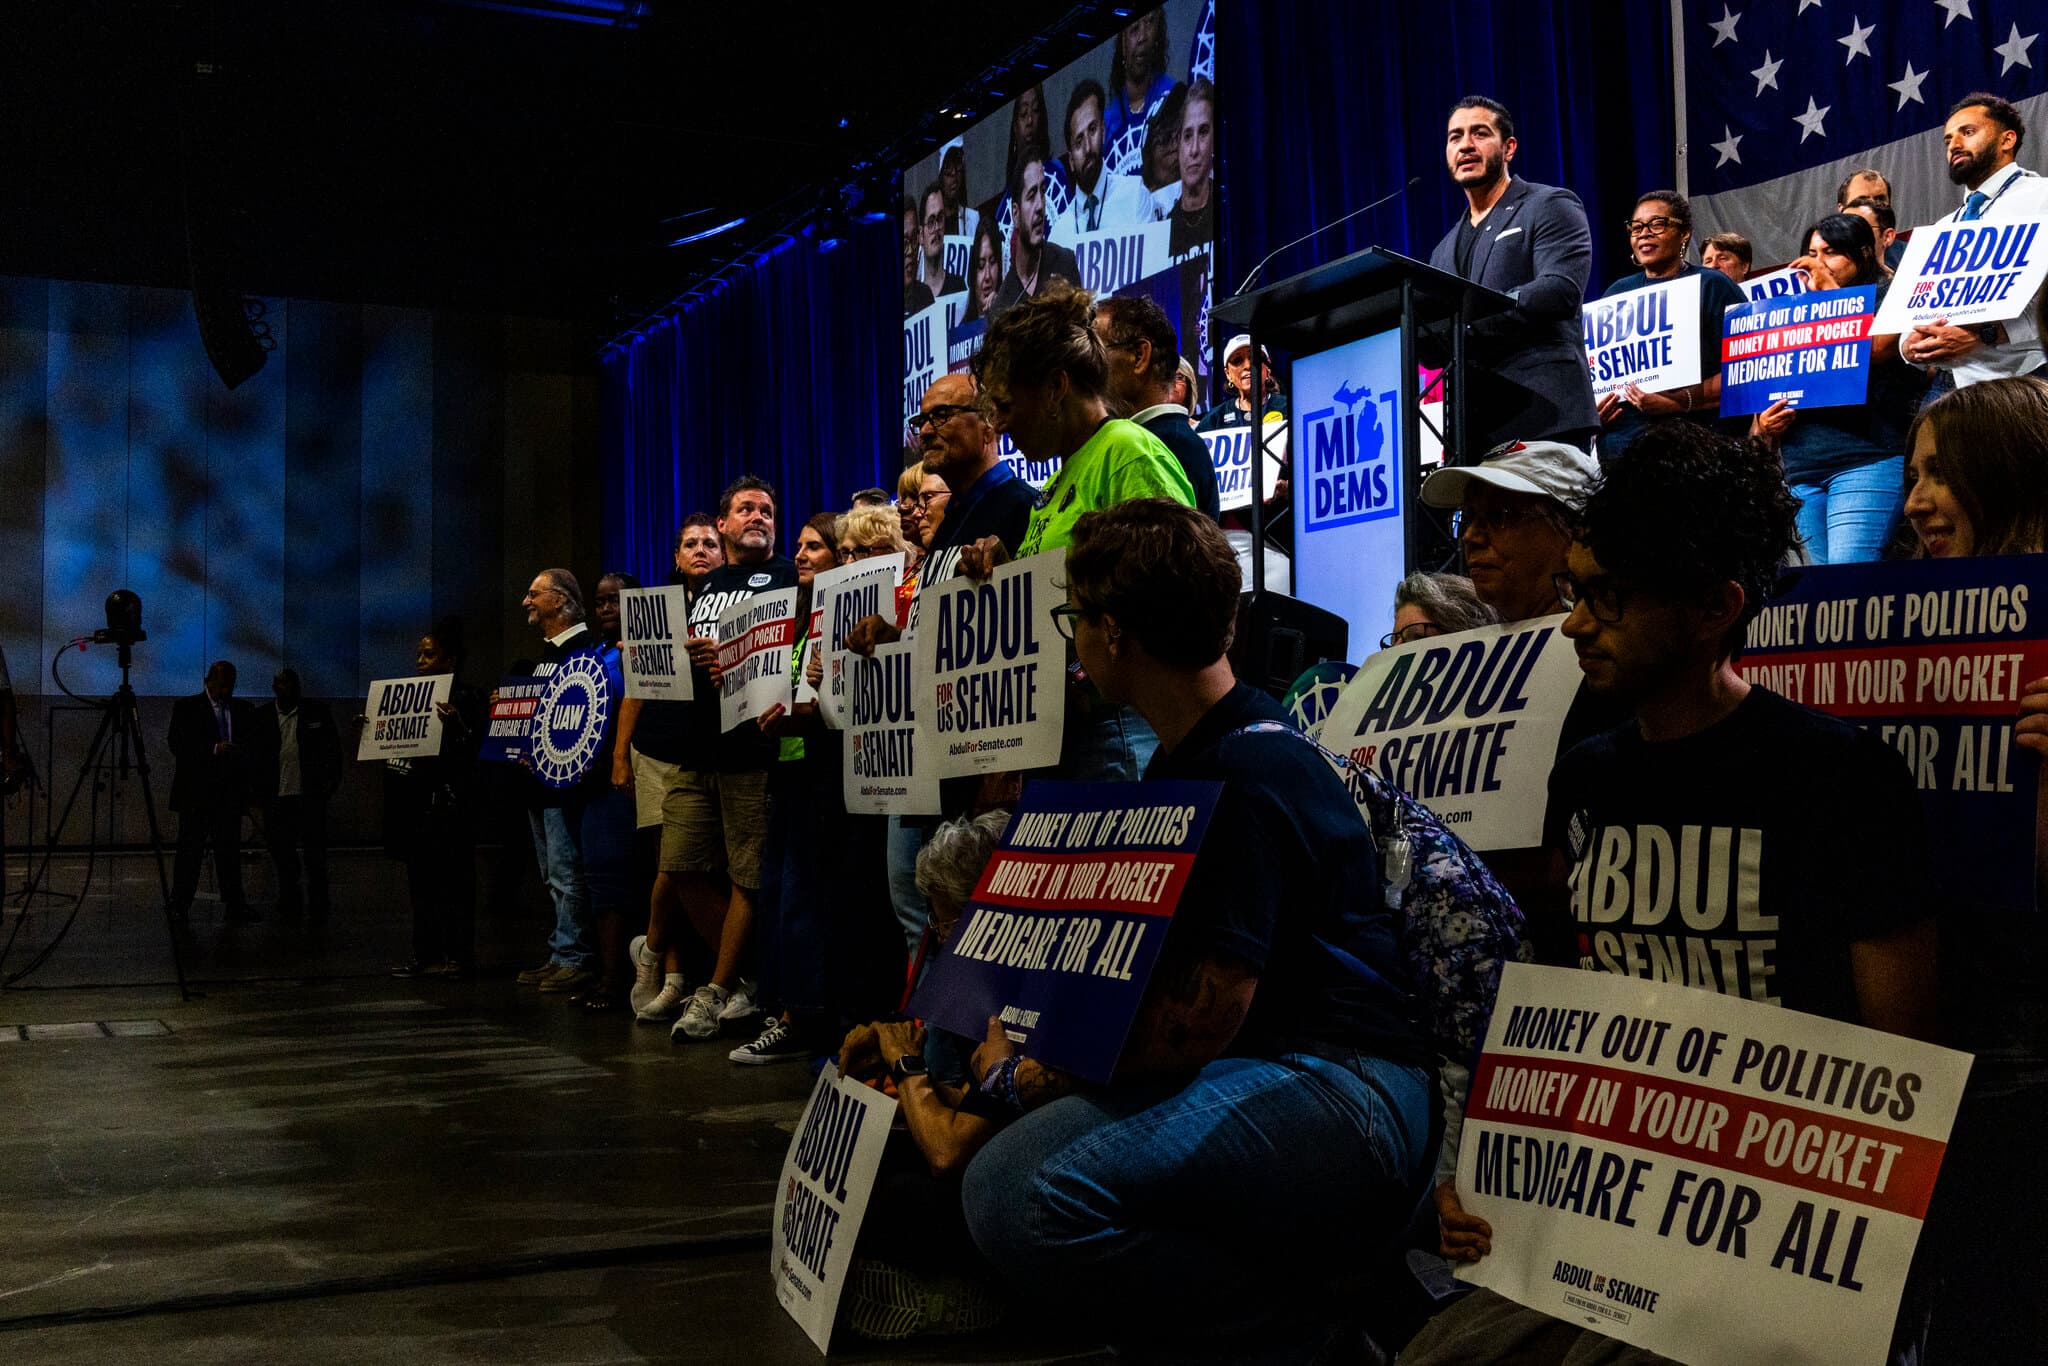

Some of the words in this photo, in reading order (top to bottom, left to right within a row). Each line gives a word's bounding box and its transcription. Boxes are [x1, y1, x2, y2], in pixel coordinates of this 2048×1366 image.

[1920, 223, 2040, 276] ABDUL
[1907, 293, 1930, 308] US
[1930, 271, 2022, 309] SENATE
[1913, 281, 1935, 295] FOR
[1582, 289, 1673, 351] ABDUL
[1730, 312, 1766, 335] MONEY
[1769, 308, 1791, 327] OUT
[1793, 305, 1808, 323] OF
[1810, 296, 1865, 320] POLITICS
[904, 316, 934, 379] DUL
[950, 338, 973, 364] MONEY
[1598, 335, 1673, 381] SENATE
[1729, 335, 1767, 357] MONEY
[1766, 332, 1779, 350] IN
[1782, 327, 1812, 347] YOUR
[1816, 319, 1863, 342] POCKET
[1728, 353, 1794, 386] MEDICARE
[1798, 348, 1828, 375] FOR
[1831, 343, 1860, 370] ALL
[1315, 413, 1355, 473] MI
[1315, 464, 1388, 519] DEMS
[626, 594, 672, 641] ABDUL
[688, 590, 754, 626] ABD
[736, 613, 747, 635] OUT
[753, 599, 788, 625] POLITICS
[935, 571, 1039, 674] ABDUL
[1744, 603, 1809, 649] MONEY
[1815, 598, 1858, 644] OUT
[1865, 595, 1895, 640] OF
[1903, 584, 2028, 638] POLITICS
[629, 646, 637, 658] FOR
[695, 623, 720, 640] SEN
[754, 624, 786, 648] POCKET
[631, 657, 640, 674] US
[638, 645, 676, 676] SENATE
[761, 650, 782, 677] ALL
[1354, 627, 1555, 736] ABDUL
[1742, 664, 1806, 705] MONEY
[1814, 662, 1836, 705] IN
[1845, 659, 1907, 705] YOUR
[1915, 654, 2025, 703] POCKET
[377, 681, 436, 716] ABDUL
[832, 676, 841, 696] US
[853, 652, 915, 726] ABDUL
[937, 682, 953, 708] FOR
[937, 703, 953, 733] US
[956, 662, 1037, 734] SENATE
[375, 728, 386, 741] US
[386, 715, 431, 741] SENATE
[489, 719, 522, 737] MEDICARE
[521, 719, 531, 736] FO
[552, 705, 586, 730] UAW
[854, 752, 863, 776] US
[949, 735, 1023, 756] AbdulForSenate.com
[1379, 720, 1516, 800] SENATE
[1952, 725, 2014, 793] ALL
[1010, 812, 1073, 848] MONEY
[1065, 811, 1102, 848] OUT
[1094, 809, 1122, 846] OF
[1113, 806, 1196, 846] POLITICS
[986, 860, 1051, 899] MONEY
[1043, 864, 1070, 900] IN
[1063, 862, 1106, 900] YOUR
[1099, 861, 1175, 903] POCKET
[1568, 824, 1779, 931] ABDUL
[953, 909, 1066, 970] MEDICARE
[1052, 917, 1101, 973] FOR
[1092, 920, 1147, 981] ALL
[1594, 930, 1781, 1008] SENATE
[1503, 1005, 1600, 1054] MONEY
[1601, 1014, 1671, 1066] OUT
[1676, 1027, 1728, 1077] OF
[1732, 1038, 1921, 1122] POLITICS
[794, 1078, 868, 1204] ABDUL
[1485, 1065, 1578, 1118] MONEY
[1576, 1077, 1622, 1127] IN
[1628, 1086, 1729, 1153] YOUR
[1735, 1111, 1903, 1194] POCKET
[786, 1180, 840, 1283] SENATE
[1475, 1130, 1653, 1228] MEDICARE
[1658, 1169, 1762, 1259] FOR
[1770, 1200, 1869, 1292] ALL
[1552, 1260, 1593, 1292] ABDUL
[1593, 1282, 1605, 1294] US
[1606, 1278, 1659, 1314] SENATE
